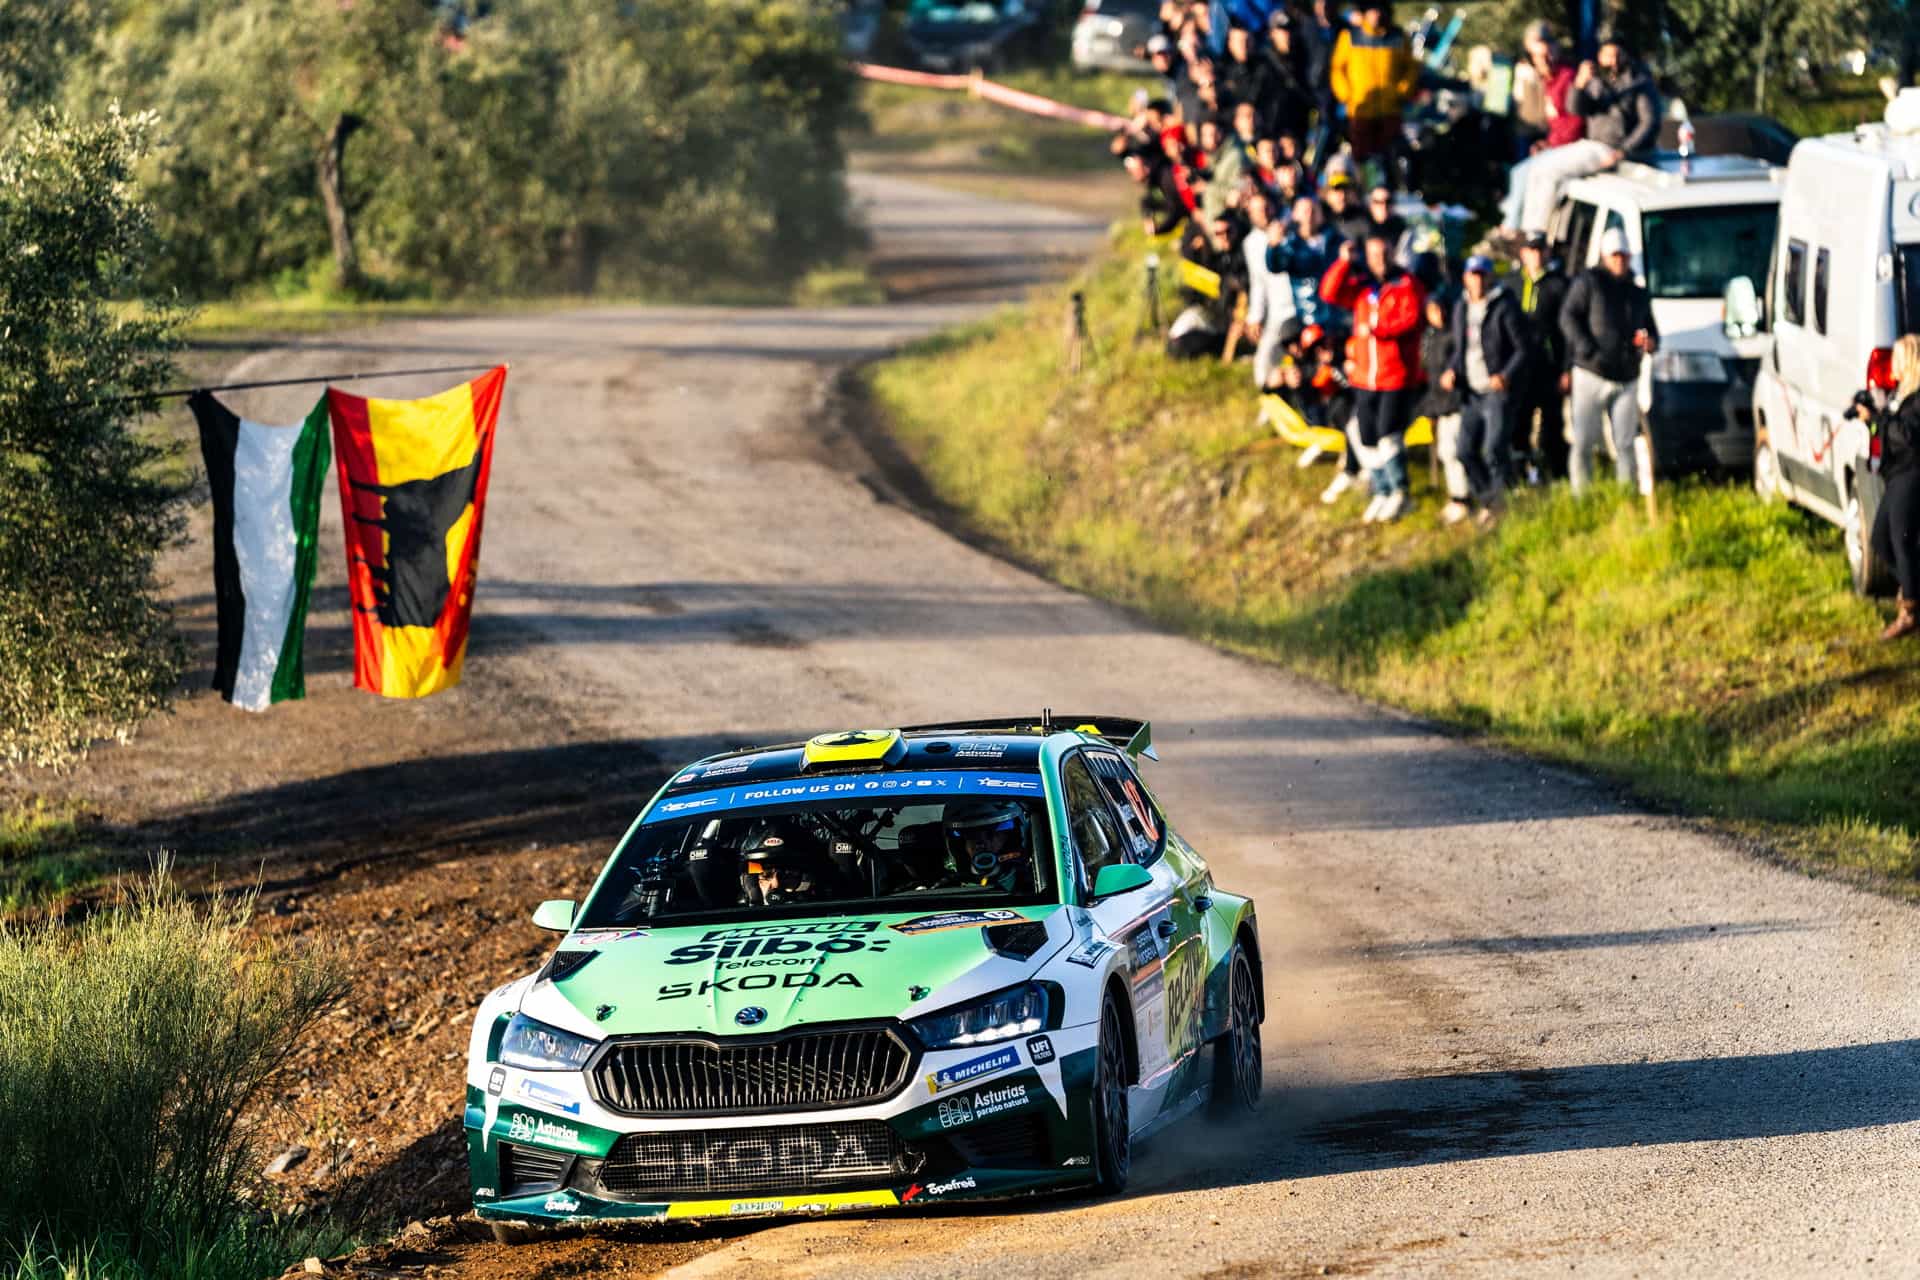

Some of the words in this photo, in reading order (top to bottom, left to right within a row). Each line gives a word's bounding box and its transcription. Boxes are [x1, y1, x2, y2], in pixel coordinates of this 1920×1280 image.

[744, 786, 806, 800] FOLLOW
[809, 783, 830, 793] US
[833, 782, 856, 791] ON
[708, 922, 874, 940] MOTUL
[715, 956, 827, 970] Telecom
[1030, 1039, 1050, 1053] UFI
[954, 1054, 1011, 1081] MICHELIN
[974, 1084, 1026, 1108] Asturias
[1003, 1096, 1030, 1110] natural
